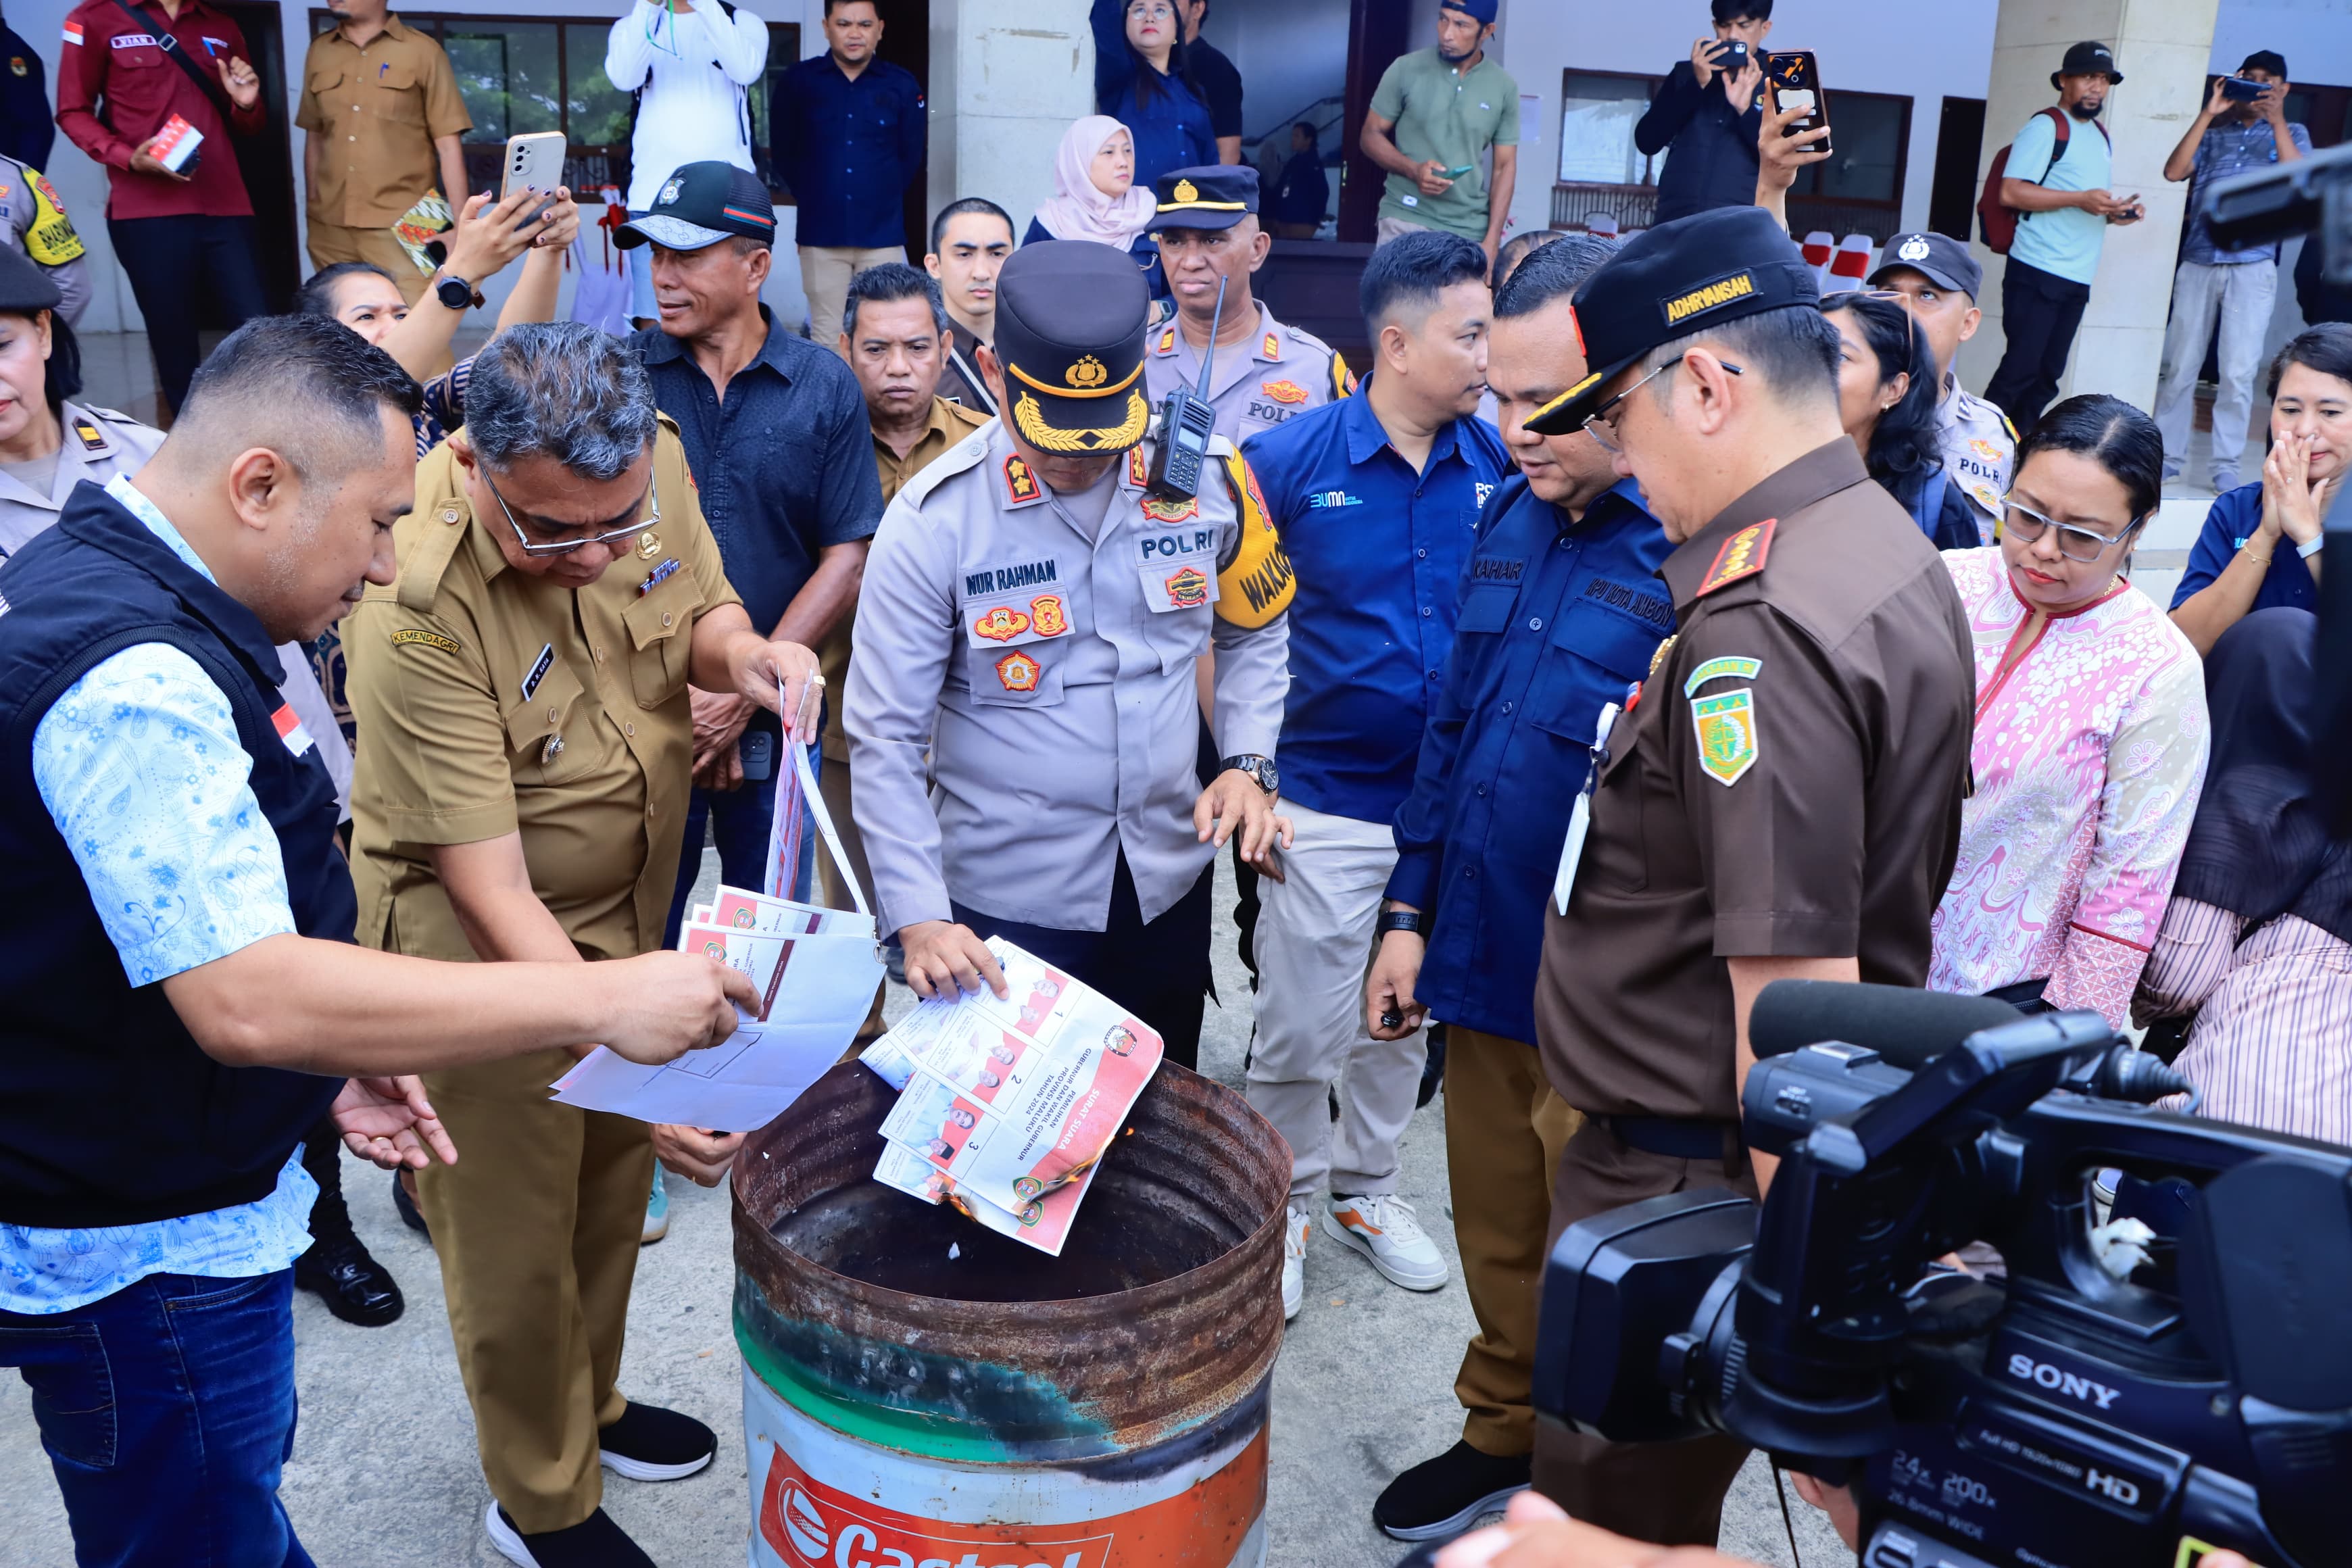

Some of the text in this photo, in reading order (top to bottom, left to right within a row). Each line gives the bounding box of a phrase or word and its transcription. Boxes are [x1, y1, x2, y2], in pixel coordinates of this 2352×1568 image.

[1667, 275, 1753, 323] ADHRYANSAH
[1248, 401, 1298, 422] POL
[1310, 491, 1345, 508] BUMN
[1141, 529, 1213, 559] POLRI
[966, 559, 1056, 595] NUR RAHMAN
[1584, 577, 1672, 627] KPU KOTA AMBON
[393, 633, 458, 654] KEMENDAGRI
[1011, 1075, 1021, 1084] 2
[1026, 1075, 1054, 1115] TAHUN 2024
[1017, 1048, 1092, 1161] GUBERNUR DAN WAKIL GUBERNUR
[1025, 1067, 1069, 1133] PROVINSI MALUKU
[1050, 1090, 1076, 1128] PEMILIHAN
[1058, 1088, 1100, 1150] SURAT SUARA
[969, 1142, 979, 1150] 3
[2007, 1354, 2121, 1409] SONY
[2086, 1467, 2140, 1506] HD
